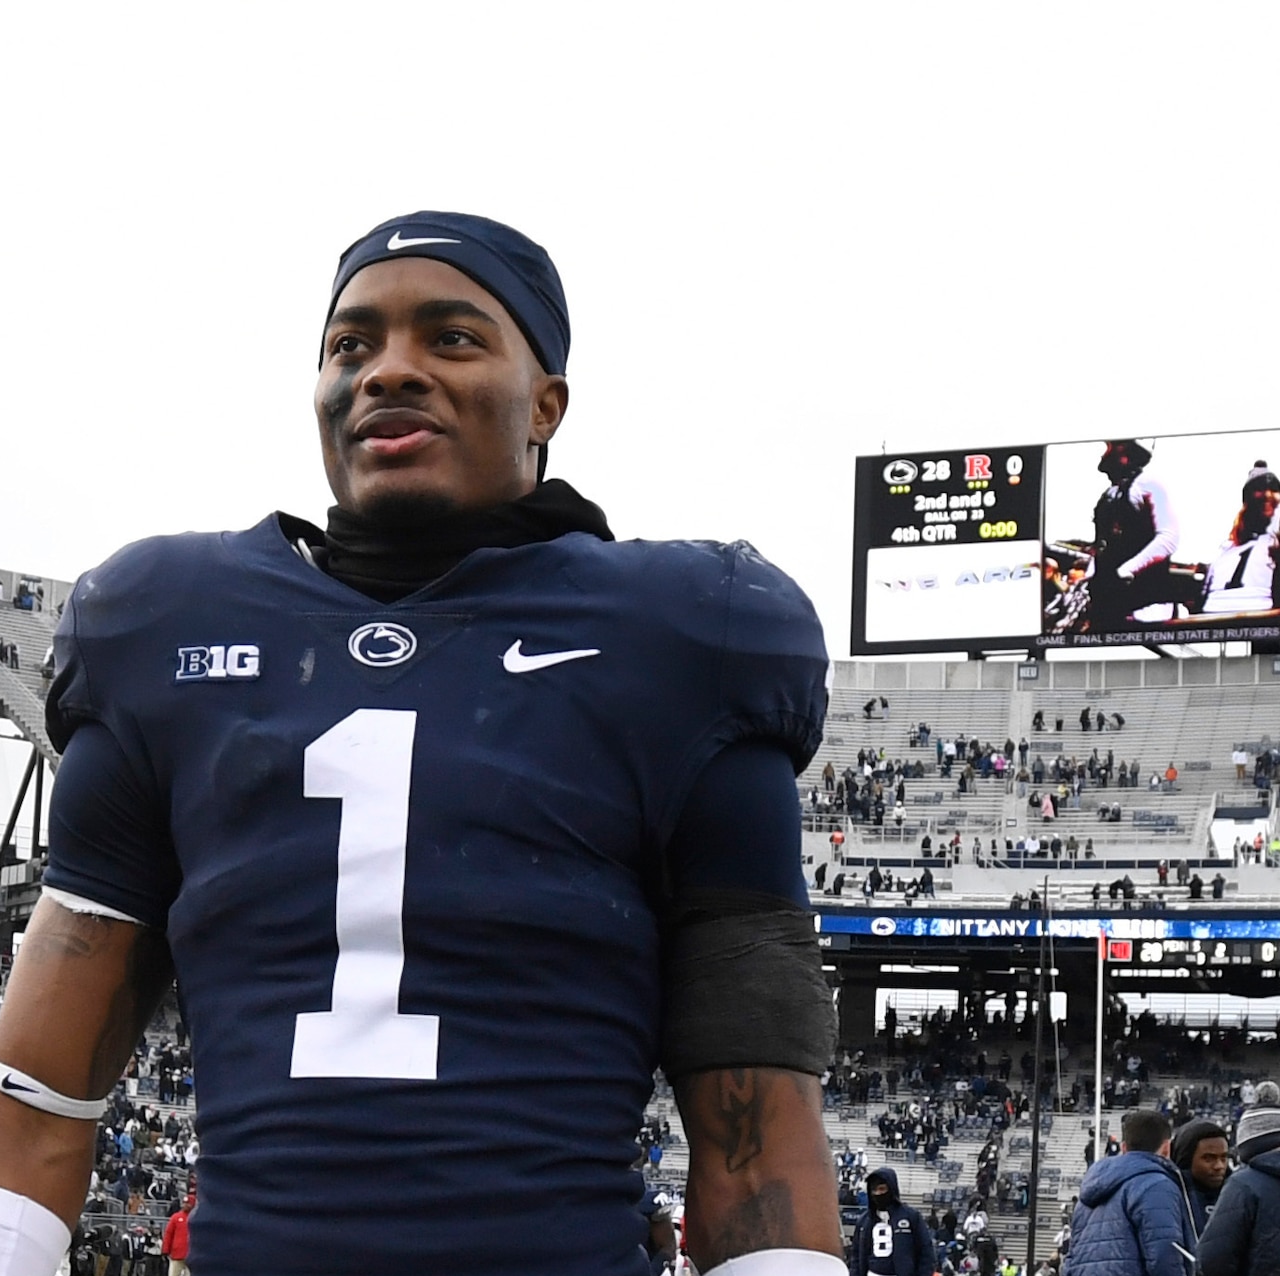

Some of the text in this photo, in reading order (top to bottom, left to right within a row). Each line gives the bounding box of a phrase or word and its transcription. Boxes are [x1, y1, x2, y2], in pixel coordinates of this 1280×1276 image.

[921, 459, 951, 482] 28
[964, 454, 993, 480] R
[1006, 454, 1023, 476] 0
[913, 491, 996, 511] 2nd and 6
[890, 523, 957, 543] 4th QTR
[978, 520, 1018, 538] 0:00
[1073, 634, 1103, 644] FINAL
[1105, 632, 1143, 643] SCORE
[1144, 631, 1175, 642] PENN
[1177, 629, 1209, 641] STATE
[1226, 626, 1280, 638] RUTGERS
[290, 707, 440, 1080] 1
[938, 919, 1031, 937] NITTANY
[871, 1221, 894, 1258] 8
